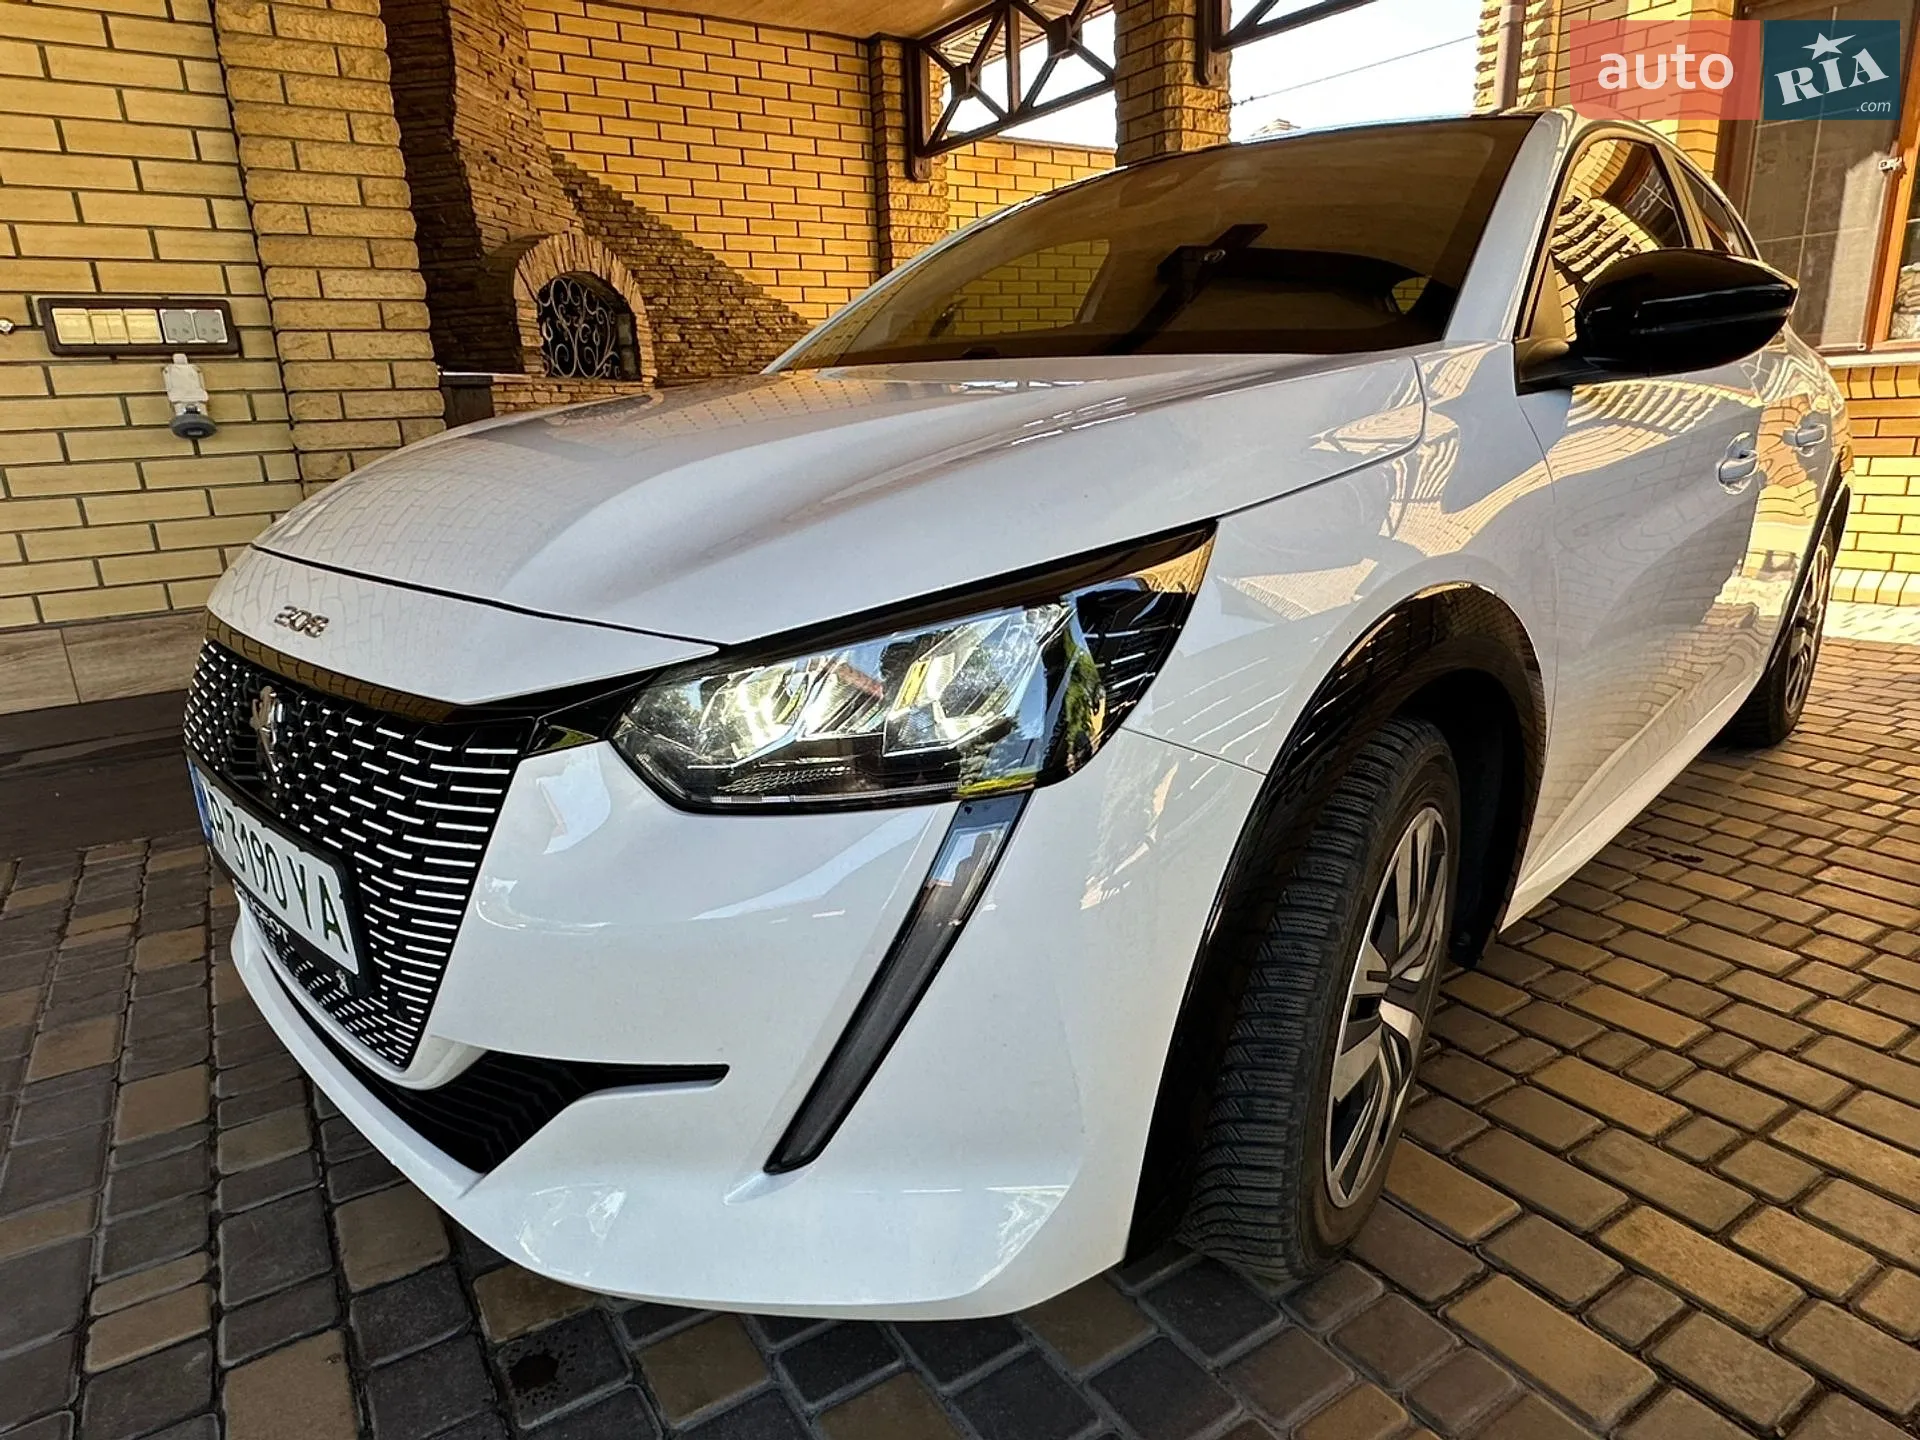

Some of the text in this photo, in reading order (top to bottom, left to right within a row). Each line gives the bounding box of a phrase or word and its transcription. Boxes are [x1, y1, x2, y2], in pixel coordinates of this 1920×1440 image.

[274, 606, 329, 637] 208
[223, 807, 287, 910] 3190
[286, 855, 350, 954] YA
